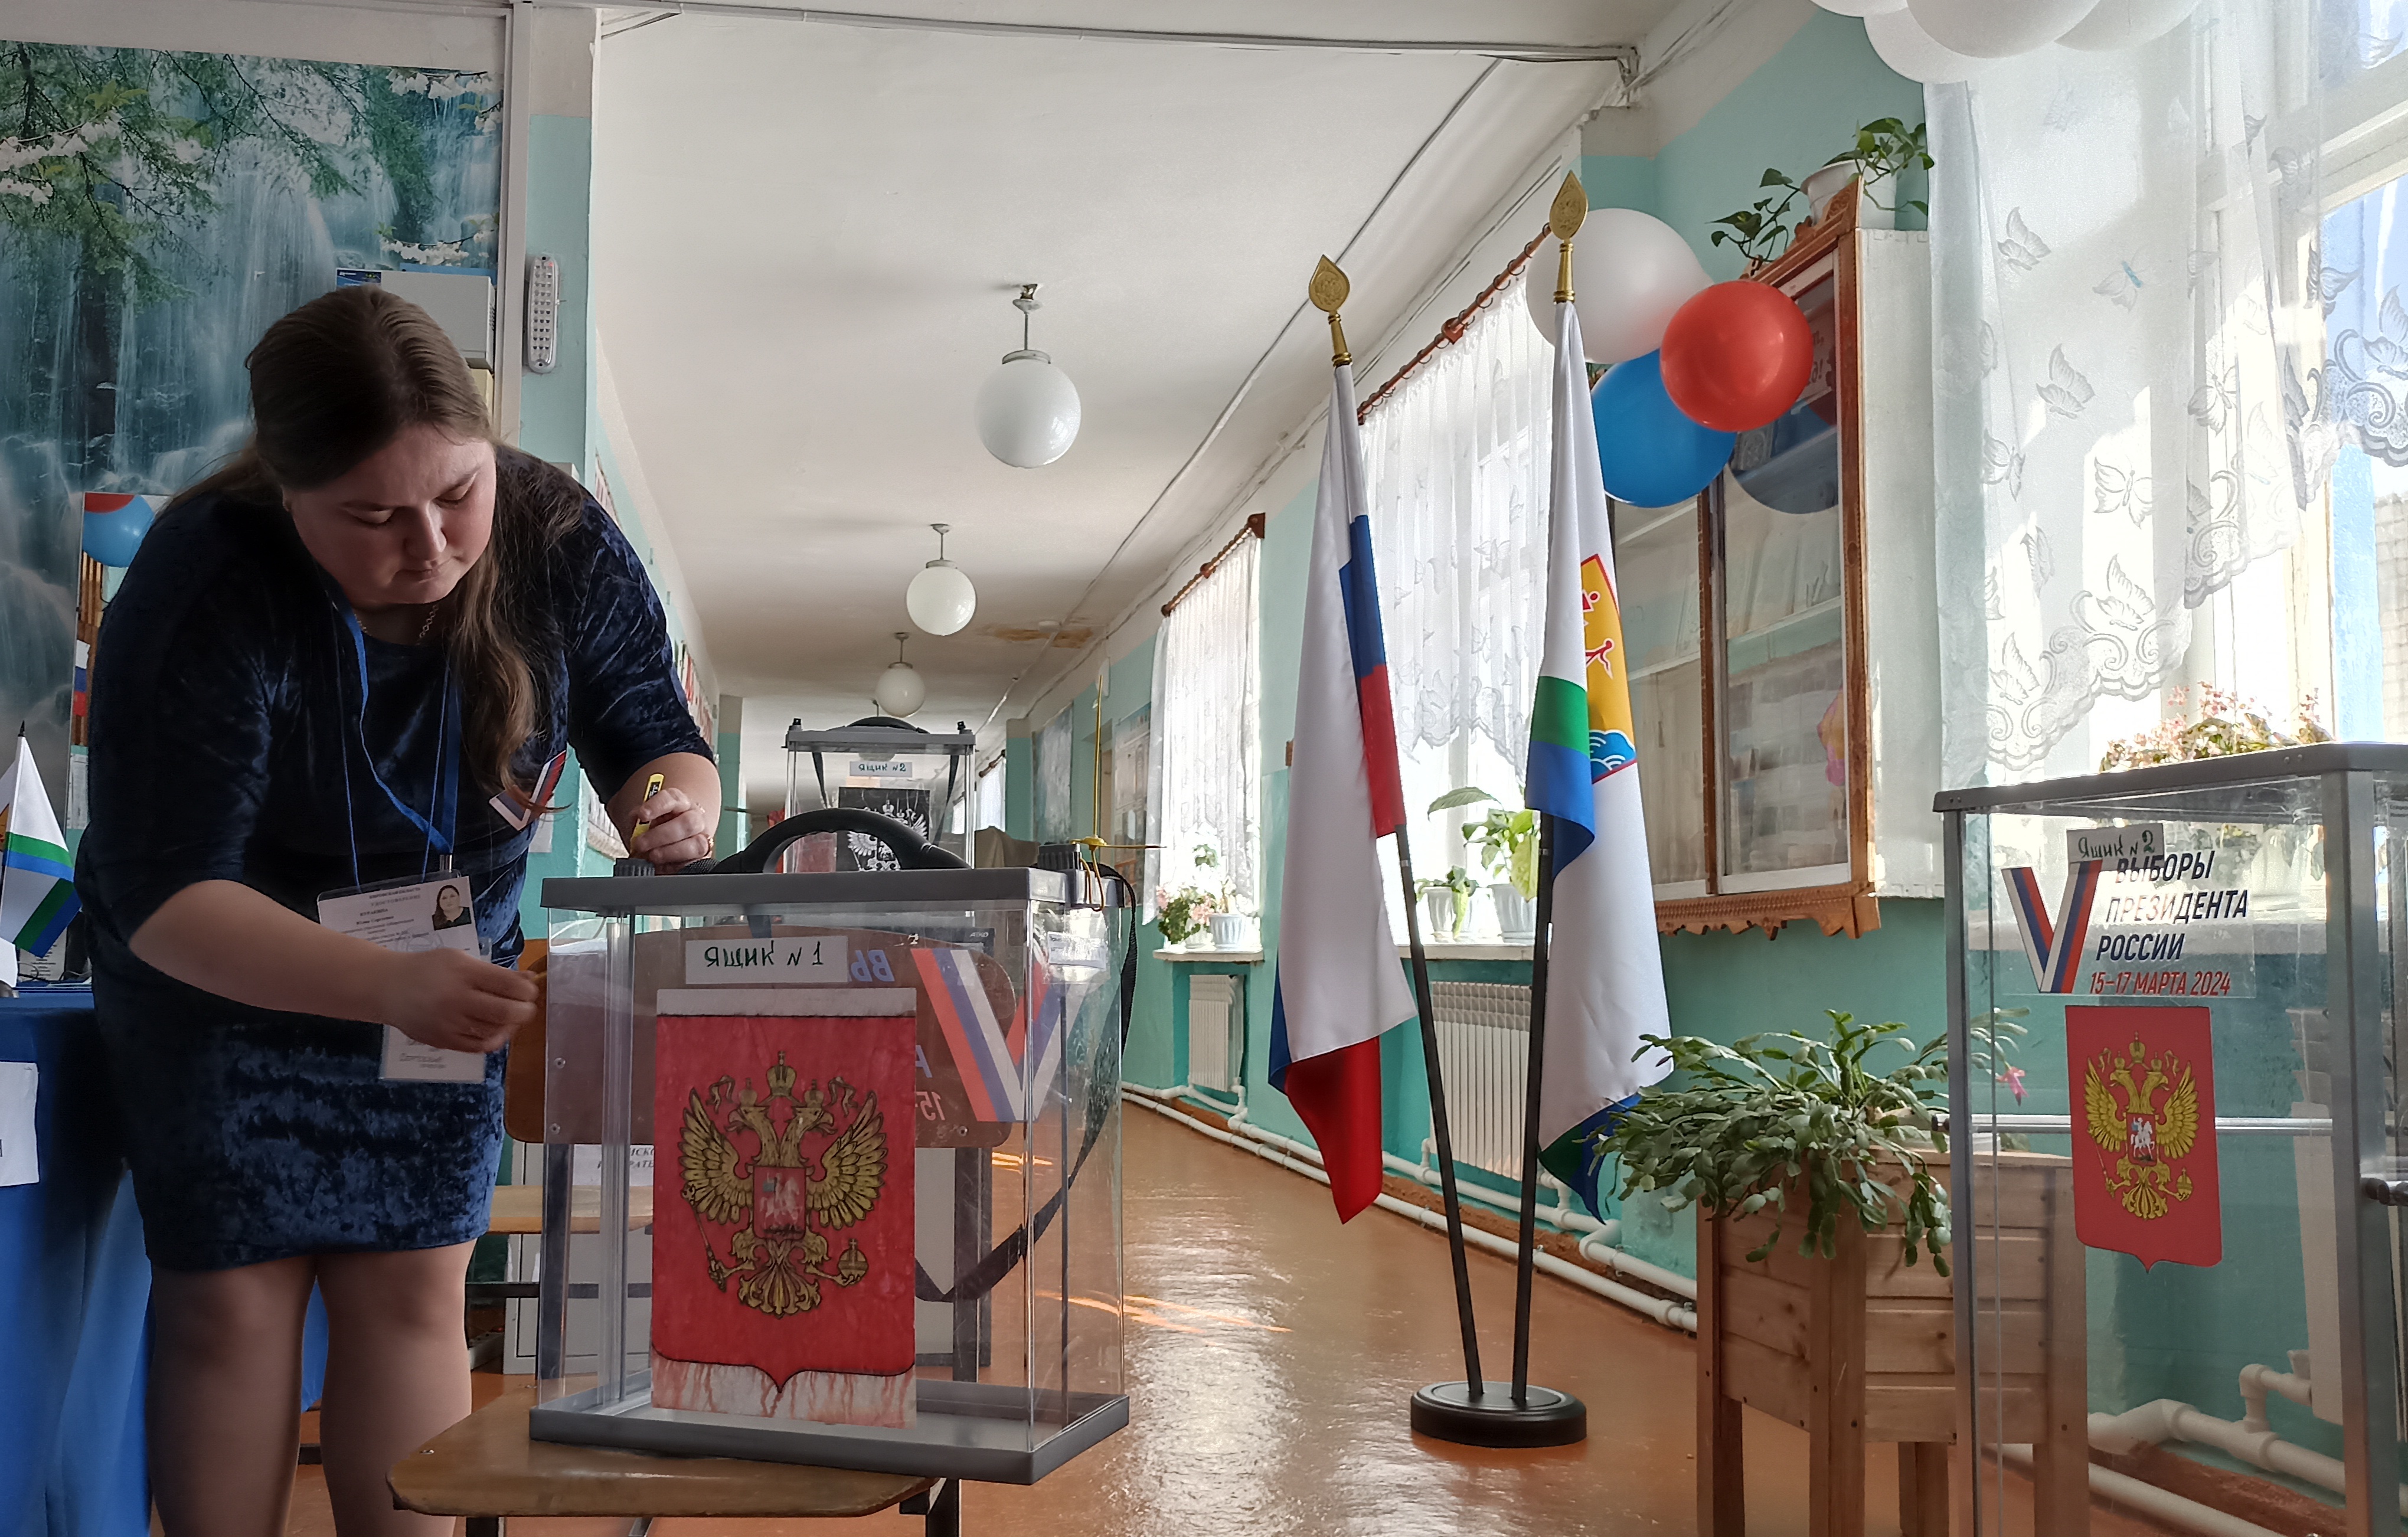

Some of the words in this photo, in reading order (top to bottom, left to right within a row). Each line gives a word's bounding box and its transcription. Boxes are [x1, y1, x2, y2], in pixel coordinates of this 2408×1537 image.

[2116, 851, 2215, 883] ВЫБОРЫ
[2106, 890, 2248, 924] ПРЕЗИДЕНТА
[2096, 933, 2185, 961] РОССИИ
[2133, 972, 2187, 995] МАРТА
[2190, 970, 2230, 996] 2024
